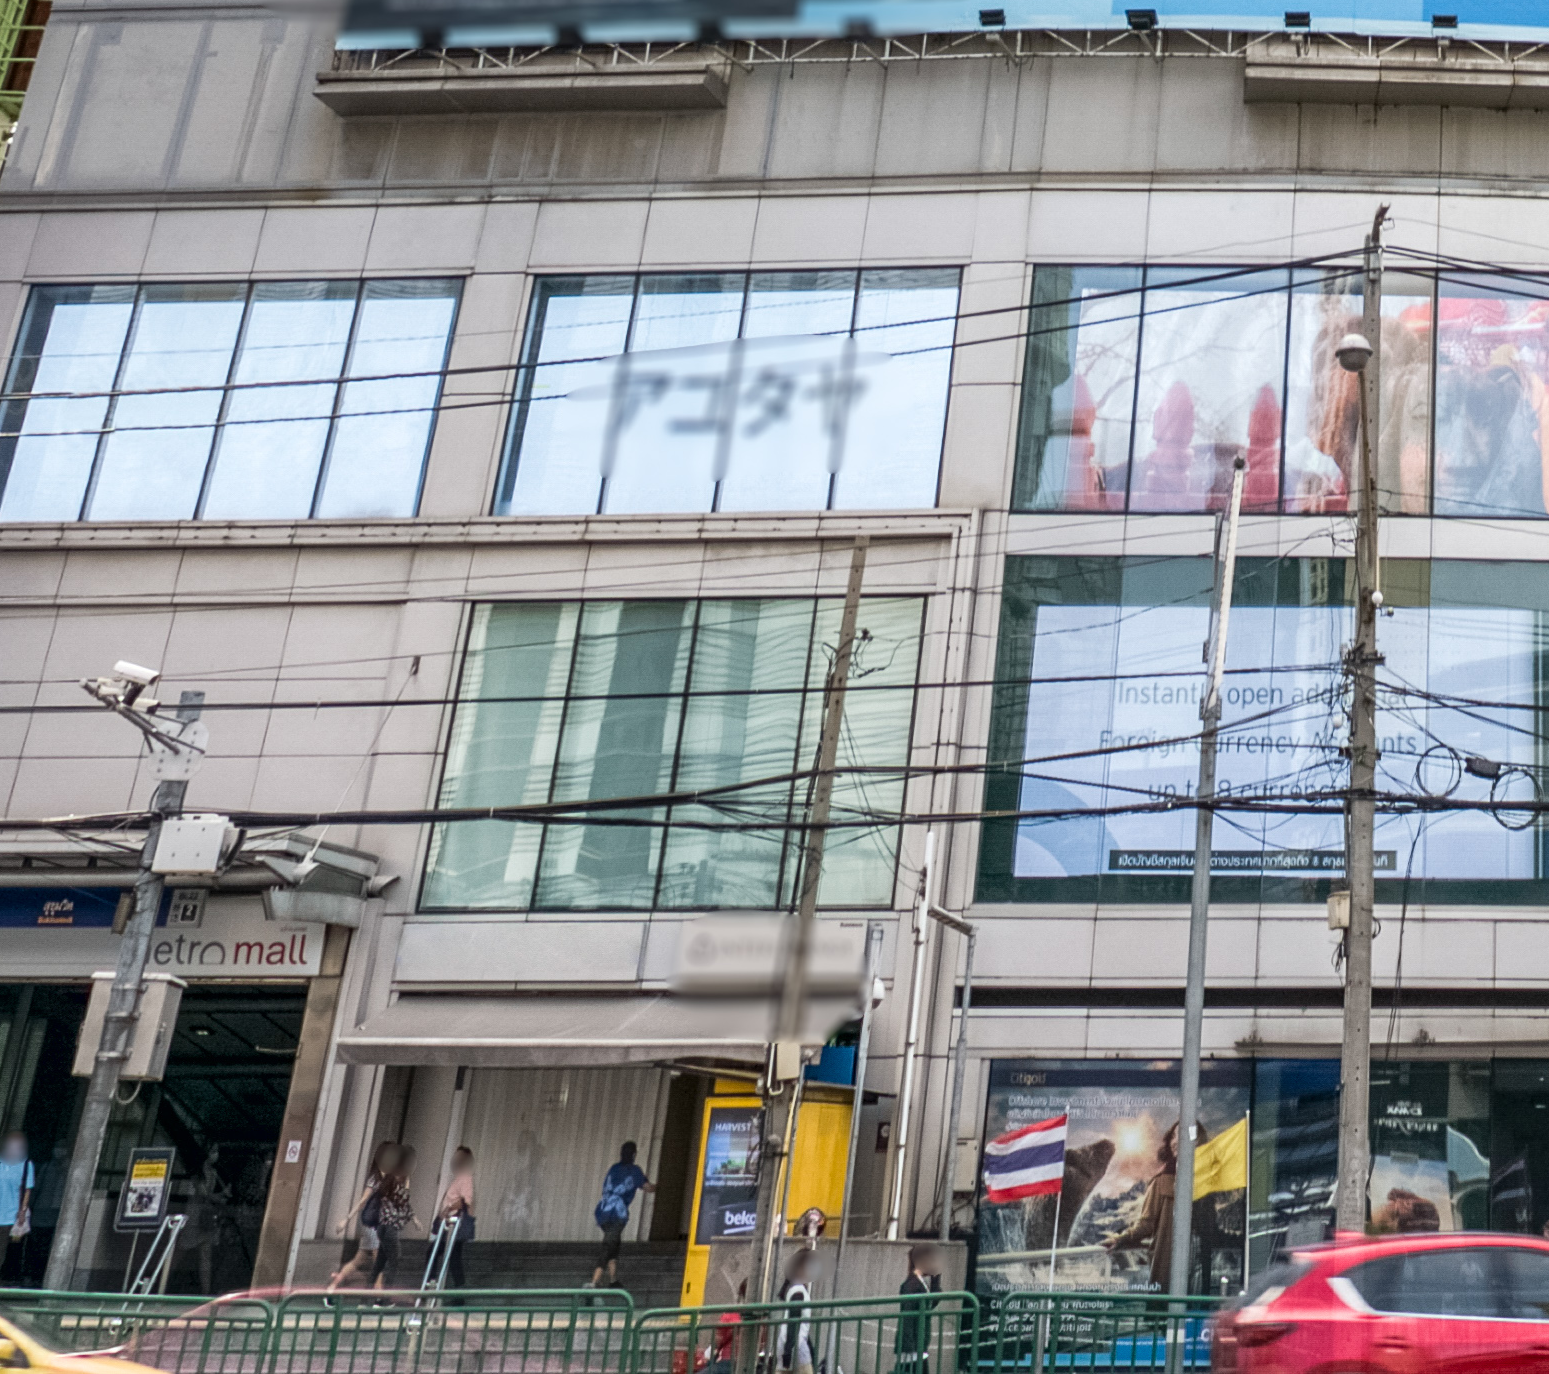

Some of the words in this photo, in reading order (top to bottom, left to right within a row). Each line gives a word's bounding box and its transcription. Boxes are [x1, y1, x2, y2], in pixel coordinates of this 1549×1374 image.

[1227, 685, 1283, 709] open
[1101, 731, 1187, 758] Foreign
[184, 904, 193, 918] 2
[146, 934, 225, 965] etro
[234, 934, 307, 965] mall
